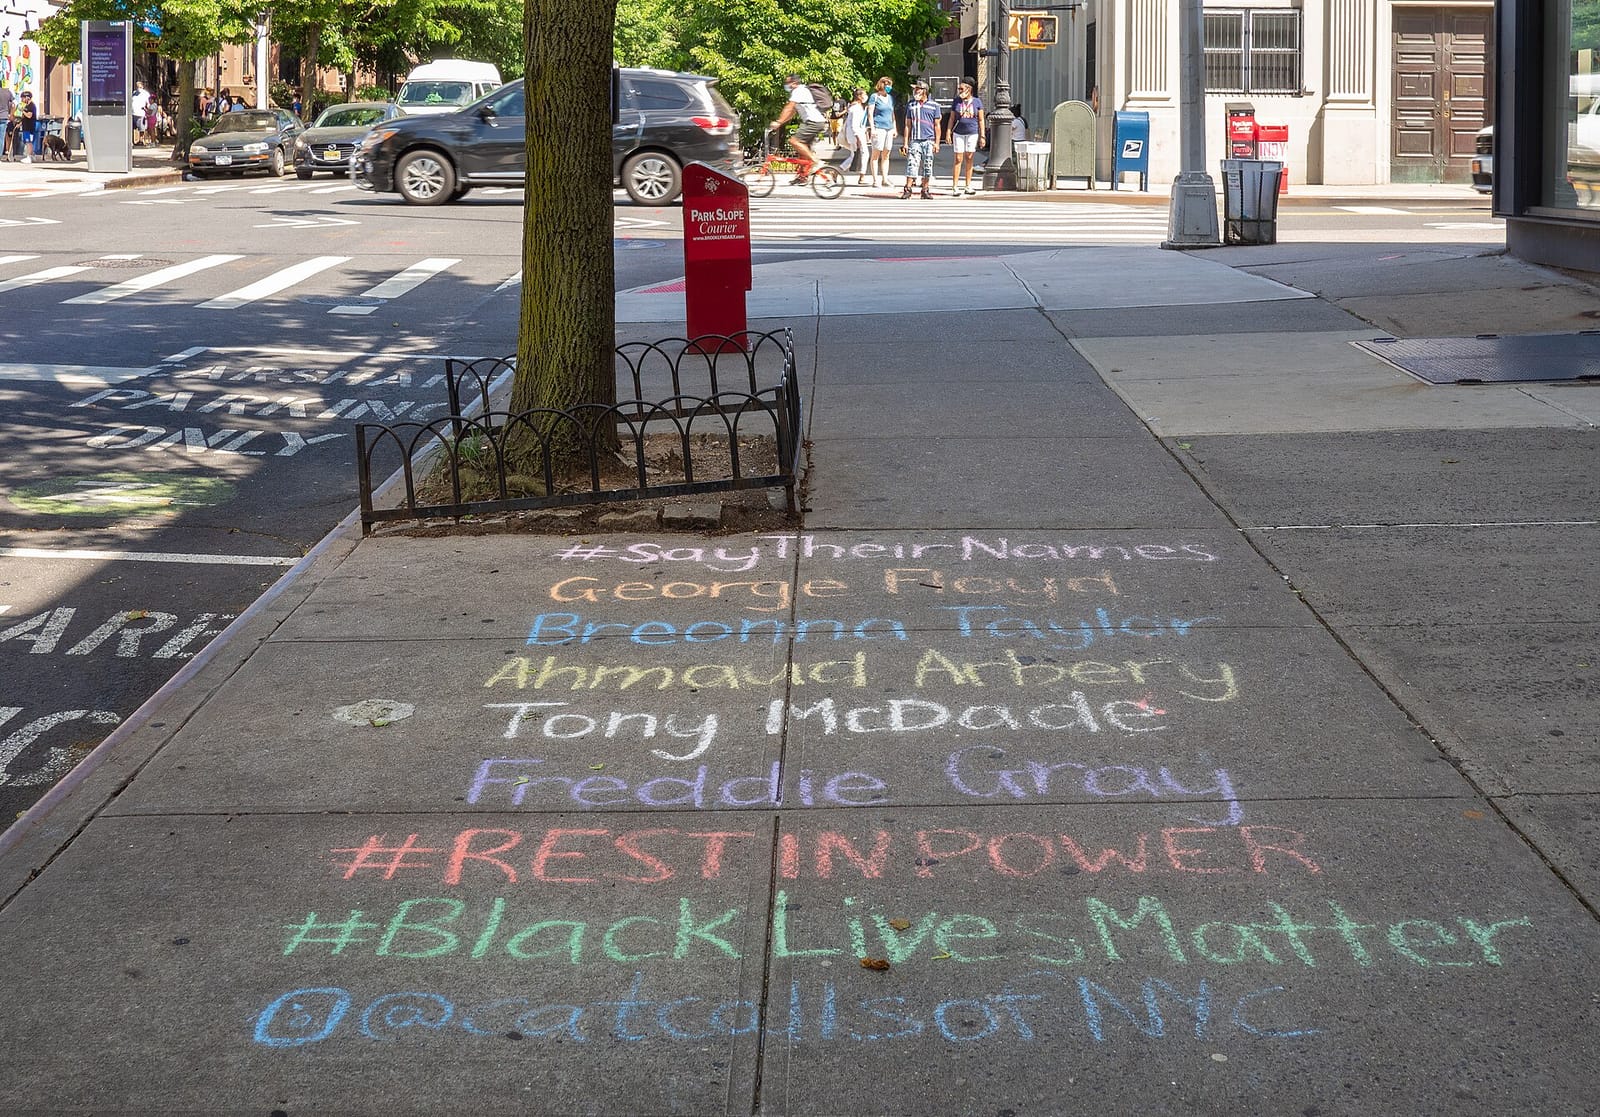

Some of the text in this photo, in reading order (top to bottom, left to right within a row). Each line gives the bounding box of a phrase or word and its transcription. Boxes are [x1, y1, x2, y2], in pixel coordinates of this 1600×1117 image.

[691, 208, 745, 222] PARK SLOPE
[699, 221, 738, 235] Courier
[67, 388, 449, 421] PARKING
[86, 424, 348, 457] ONLY
[551, 535, 1218, 572] #SayTheirNames
[549, 576, 848, 612] George
[0, 605, 238, 658] ARE
[526, 604, 1224, 650] Breonna Taylor
[483, 648, 1240, 702] Ahmaud Arbery
[483, 691, 1169, 761] Tony McDade
[467, 744, 1244, 827] Freddie Gray
